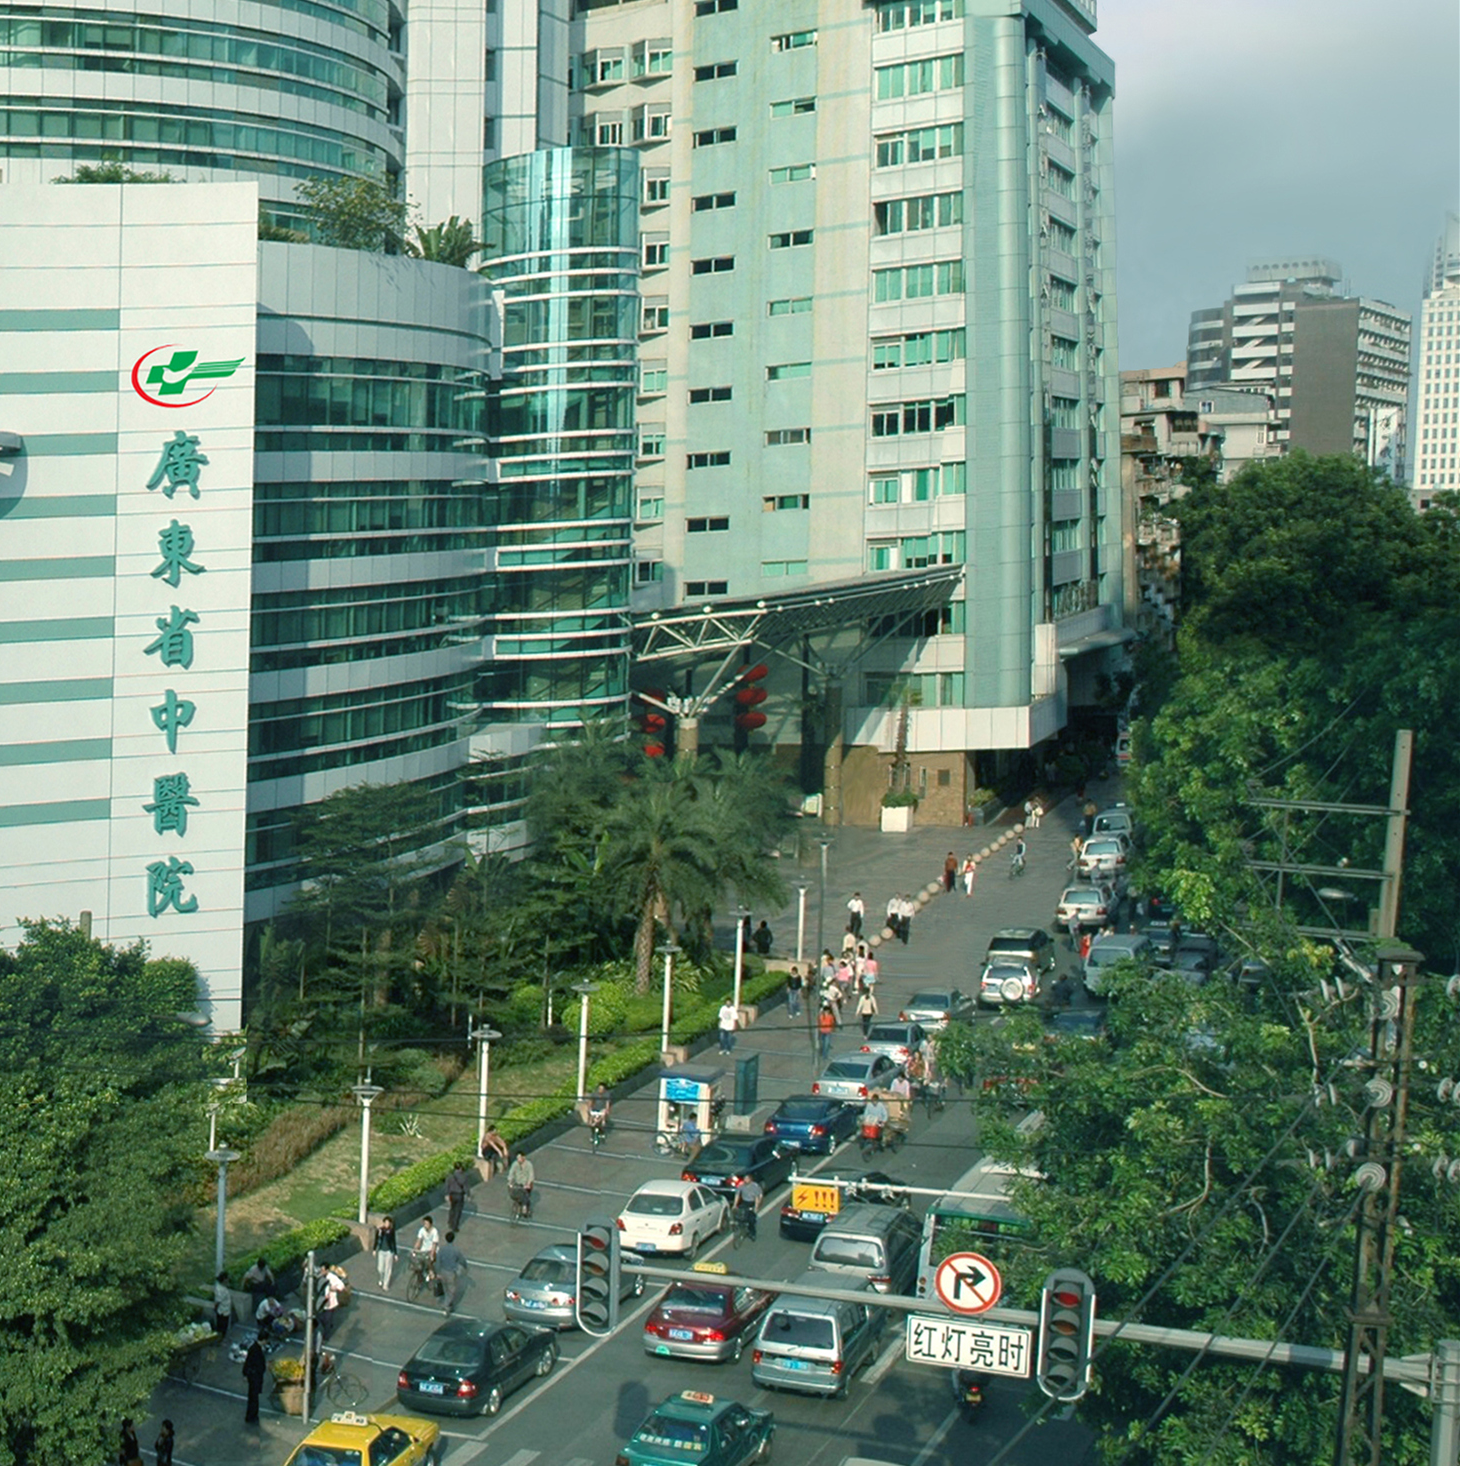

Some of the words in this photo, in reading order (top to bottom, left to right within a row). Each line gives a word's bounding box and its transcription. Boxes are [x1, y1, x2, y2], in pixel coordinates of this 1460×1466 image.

[142, 430, 209, 918] 廣東省中醫院
[913, 1323, 1024, 1371] 红灯亮时
